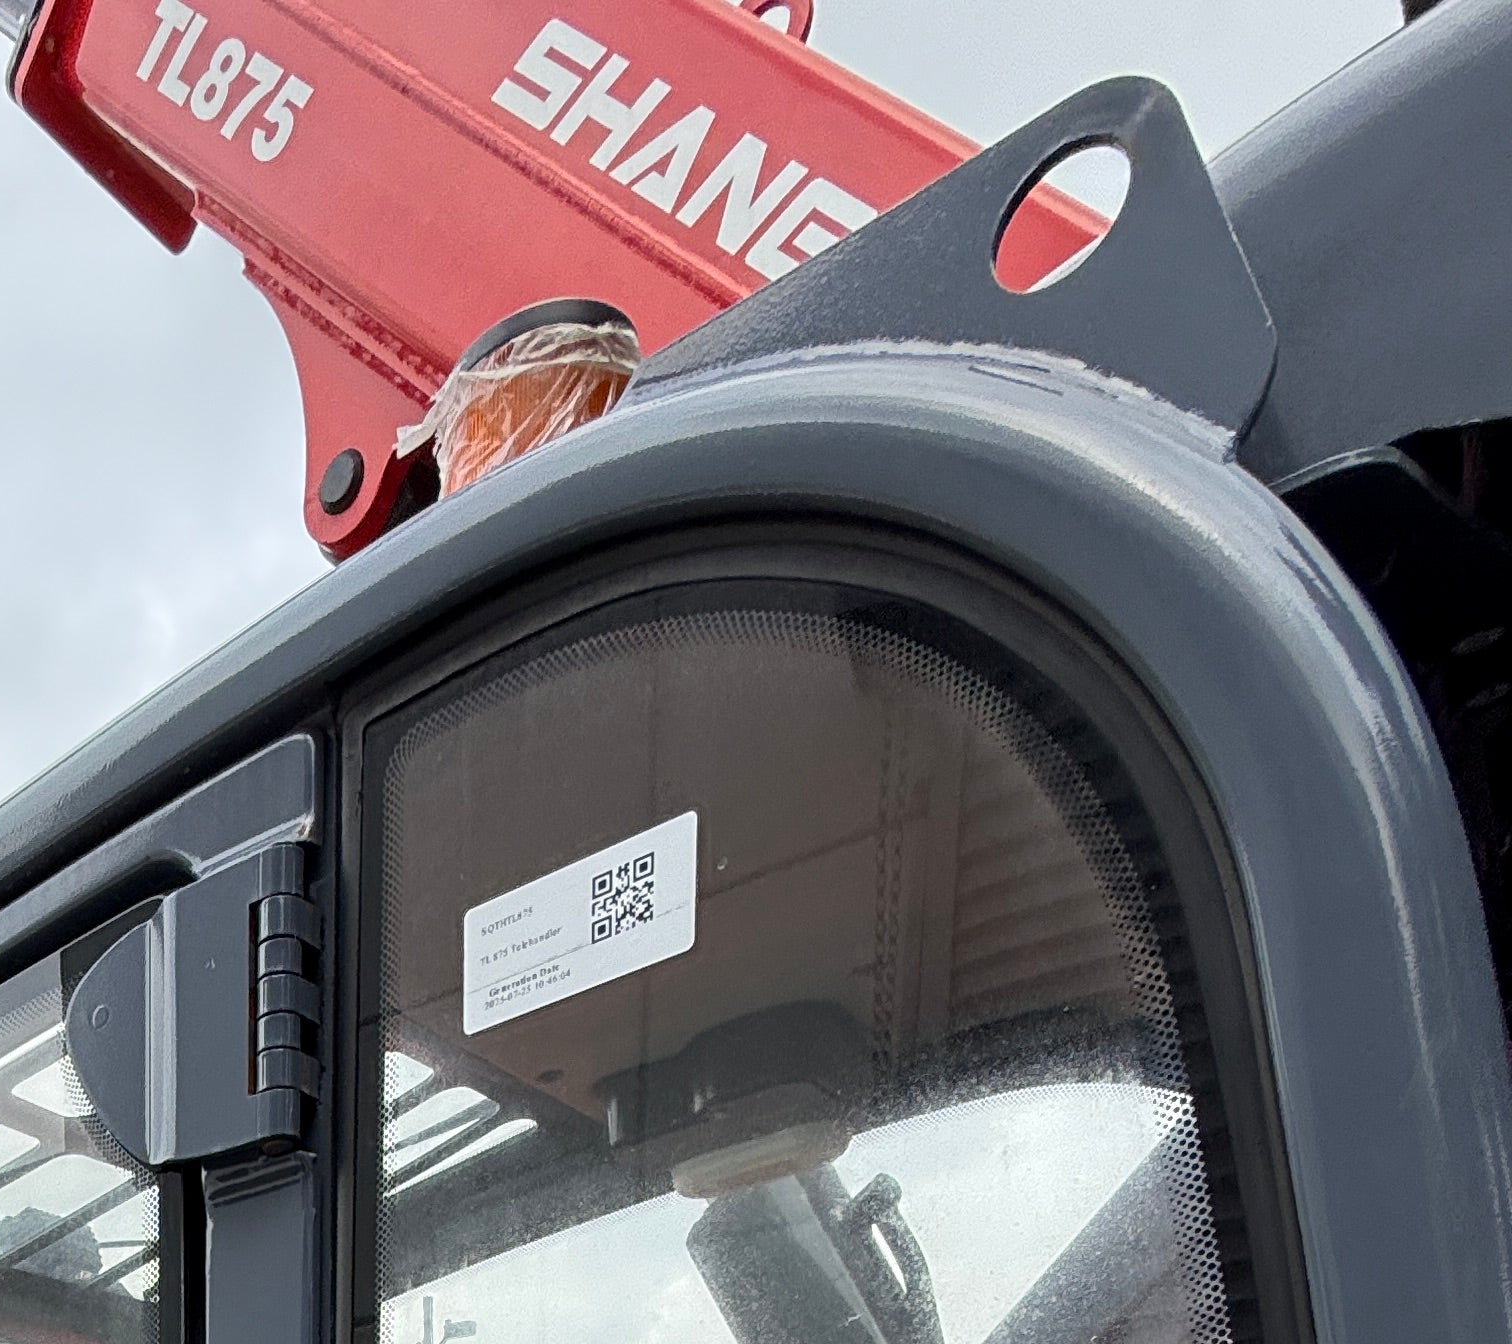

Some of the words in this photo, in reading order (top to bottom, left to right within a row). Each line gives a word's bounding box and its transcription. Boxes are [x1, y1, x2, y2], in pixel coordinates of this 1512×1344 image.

[133, 0, 314, 163] TL875
[489, 973, 537, 998] Generation
[540, 964, 561, 977] Date
